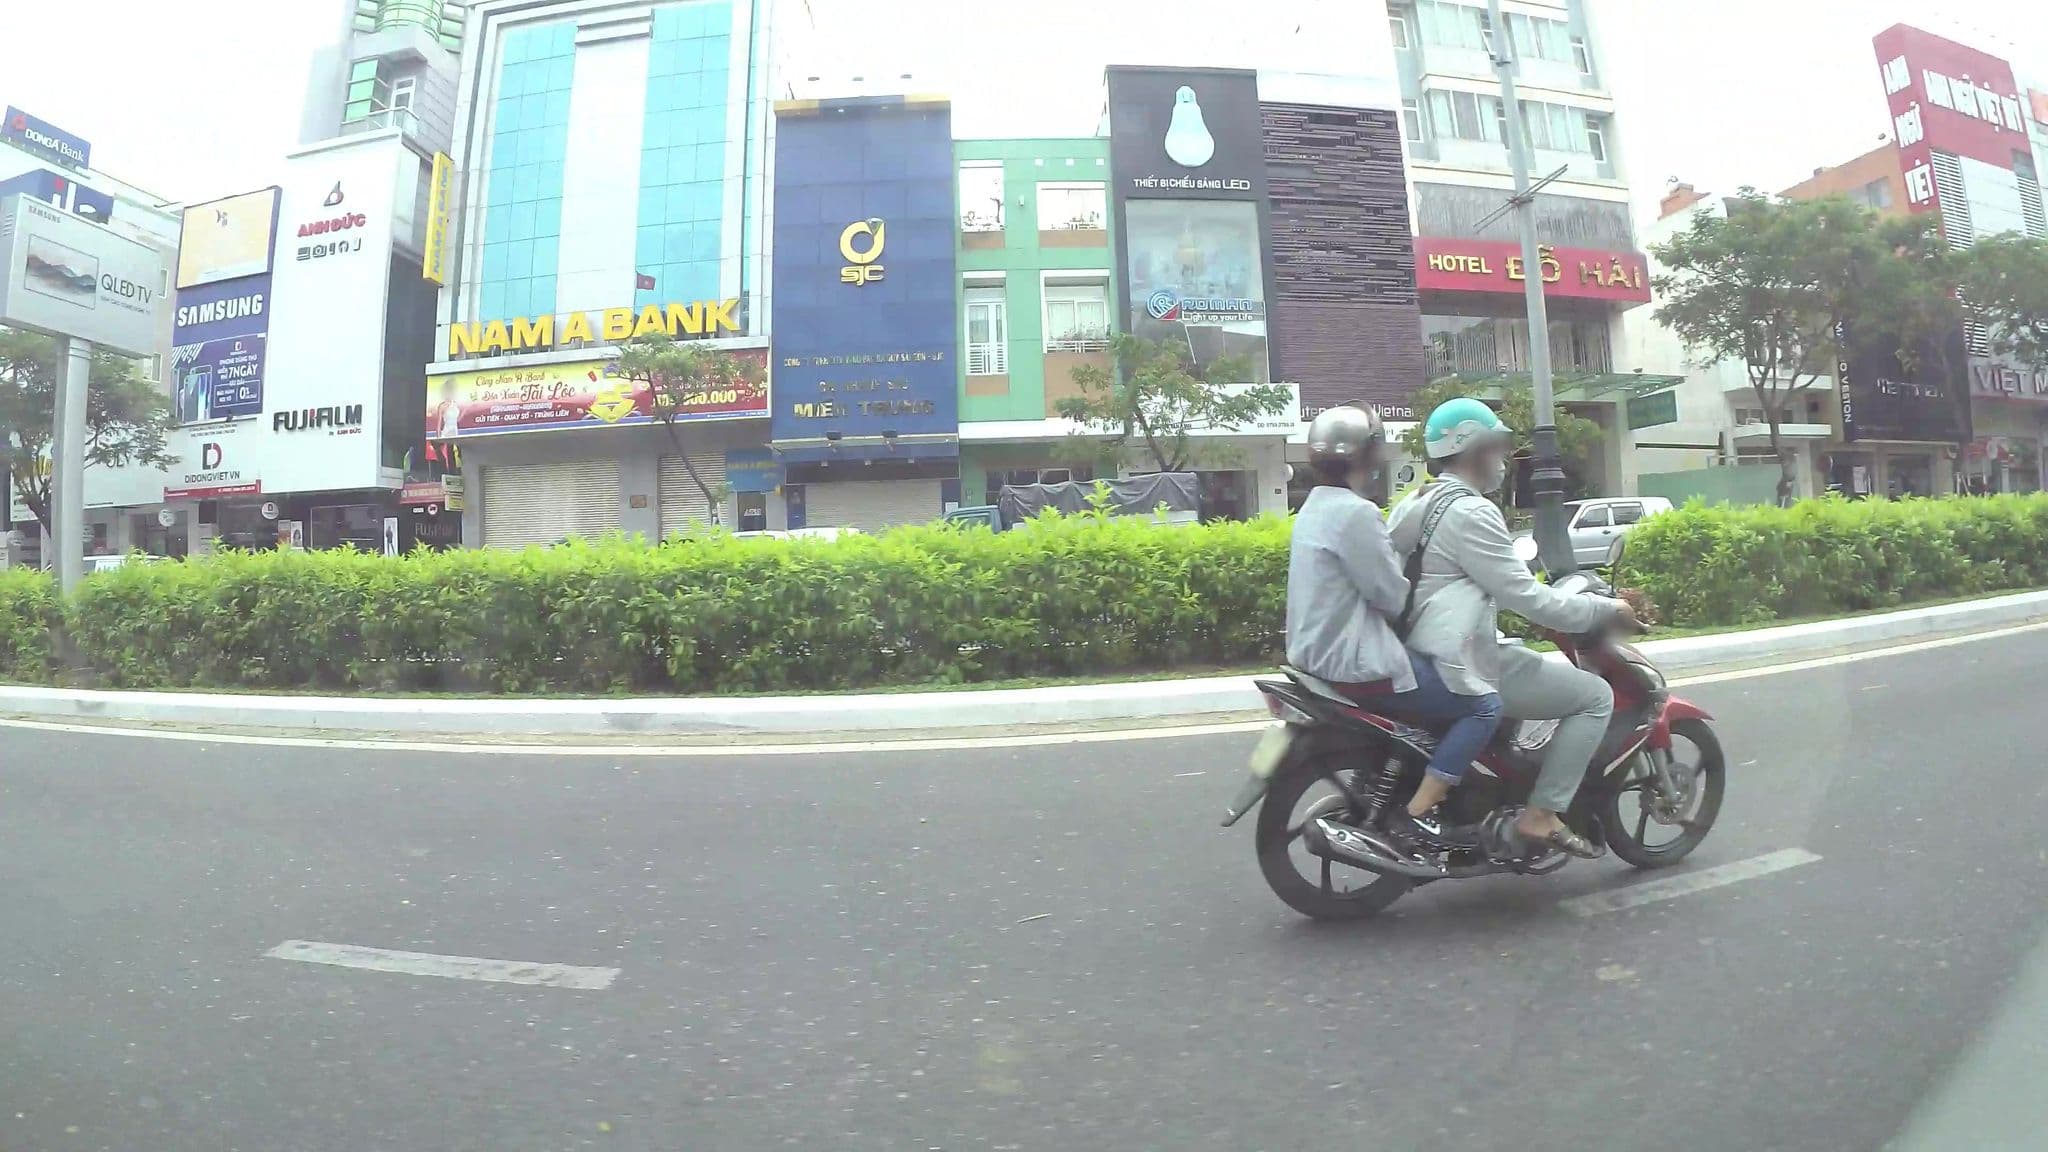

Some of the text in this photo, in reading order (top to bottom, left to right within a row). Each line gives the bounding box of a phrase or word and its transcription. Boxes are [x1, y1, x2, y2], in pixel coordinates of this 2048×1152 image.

[60, 141, 84, 162] Bank
[1133, 174, 1251, 191] THIẾT BỊ CHIẾU SÁNG LED
[1428, 253, 1493, 275] HOTEL
[840, 265, 885, 286] SJC
[101, 273, 152, 303] QLED TV
[177, 294, 263, 328] SAMSUNG
[1208, 314, 1219, 322] up
[450, 298, 742, 356] NAM A BANK
[273, 404, 363, 432] FUJIFILM
[504, 413, 520, 421] QUAY
